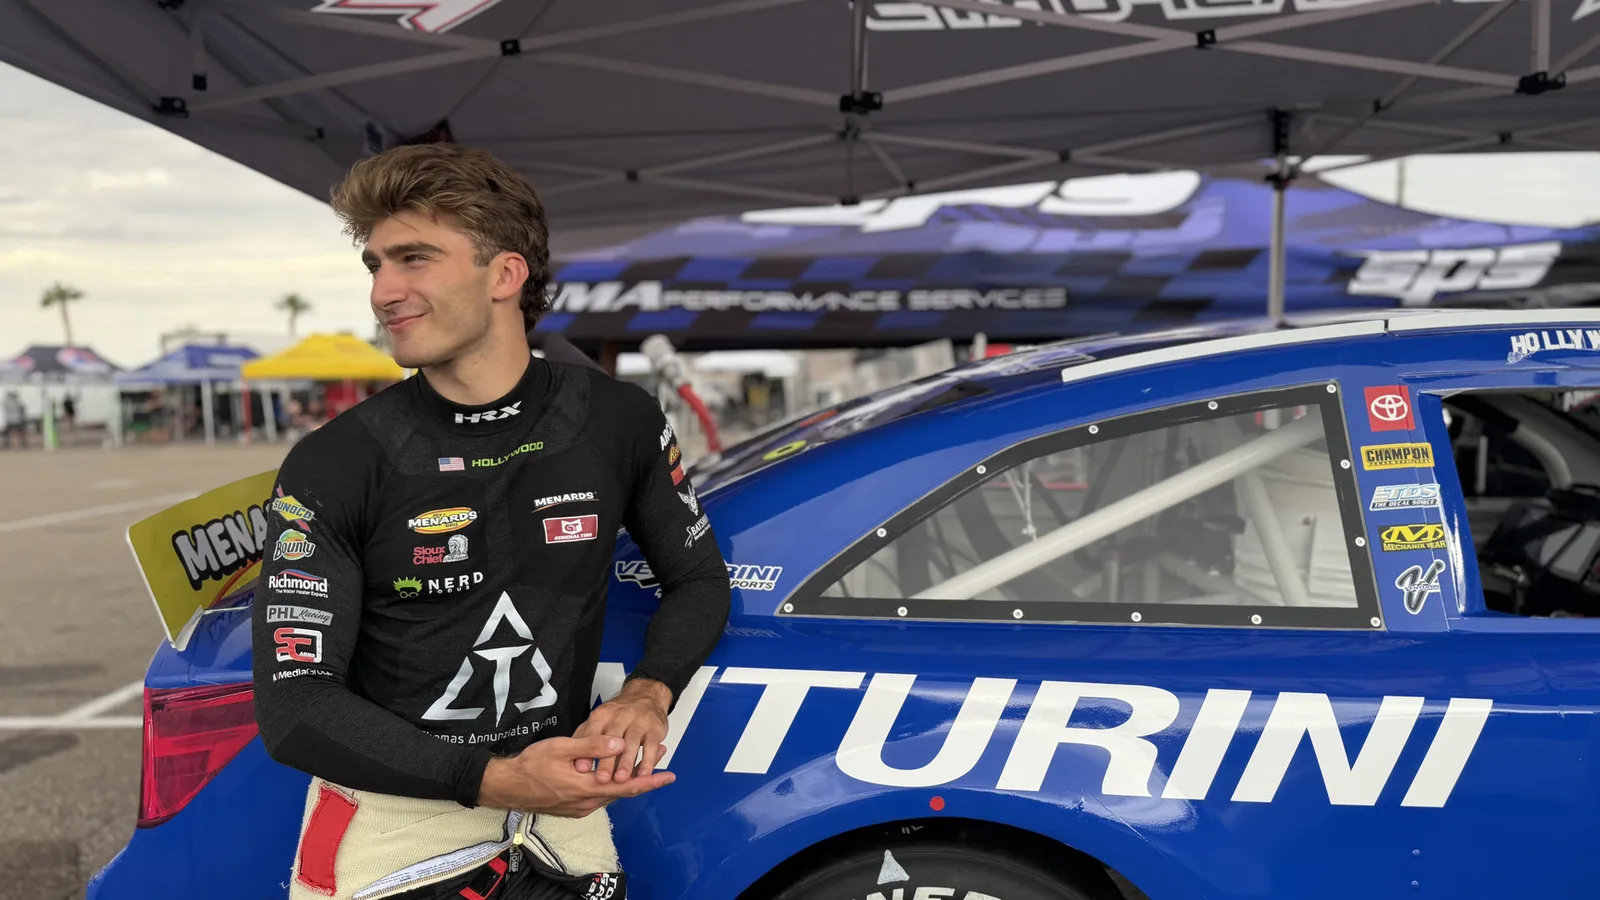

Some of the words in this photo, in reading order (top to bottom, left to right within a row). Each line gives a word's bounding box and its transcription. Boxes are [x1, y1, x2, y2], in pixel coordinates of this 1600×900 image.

[662, 288, 900, 312] PERFORMANCE
[907, 287, 1068, 311] SERVICES
[455, 401, 522, 424] HRX
[472, 441, 544, 467] HOLLYWOOD
[1366, 447, 1430, 462] CHAMPON
[535, 491, 594, 507] MENARDS
[1384, 486, 1439, 500] TDS
[272, 499, 315, 521] SUNOCO
[408, 511, 478, 528] MENARDS
[173, 501, 268, 582] MENA
[273, 540, 316, 561] Bounty
[1383, 542, 1425, 551] MECHANIX
[413, 546, 446, 556] Sioux
[413, 554, 443, 565] Chief
[269, 573, 328, 593] Richmond
[428, 571, 484, 590] NERD
[268, 607, 299, 620] PHL
[299, 608, 331, 623] Racing
[532, 715, 557, 733] Rng
